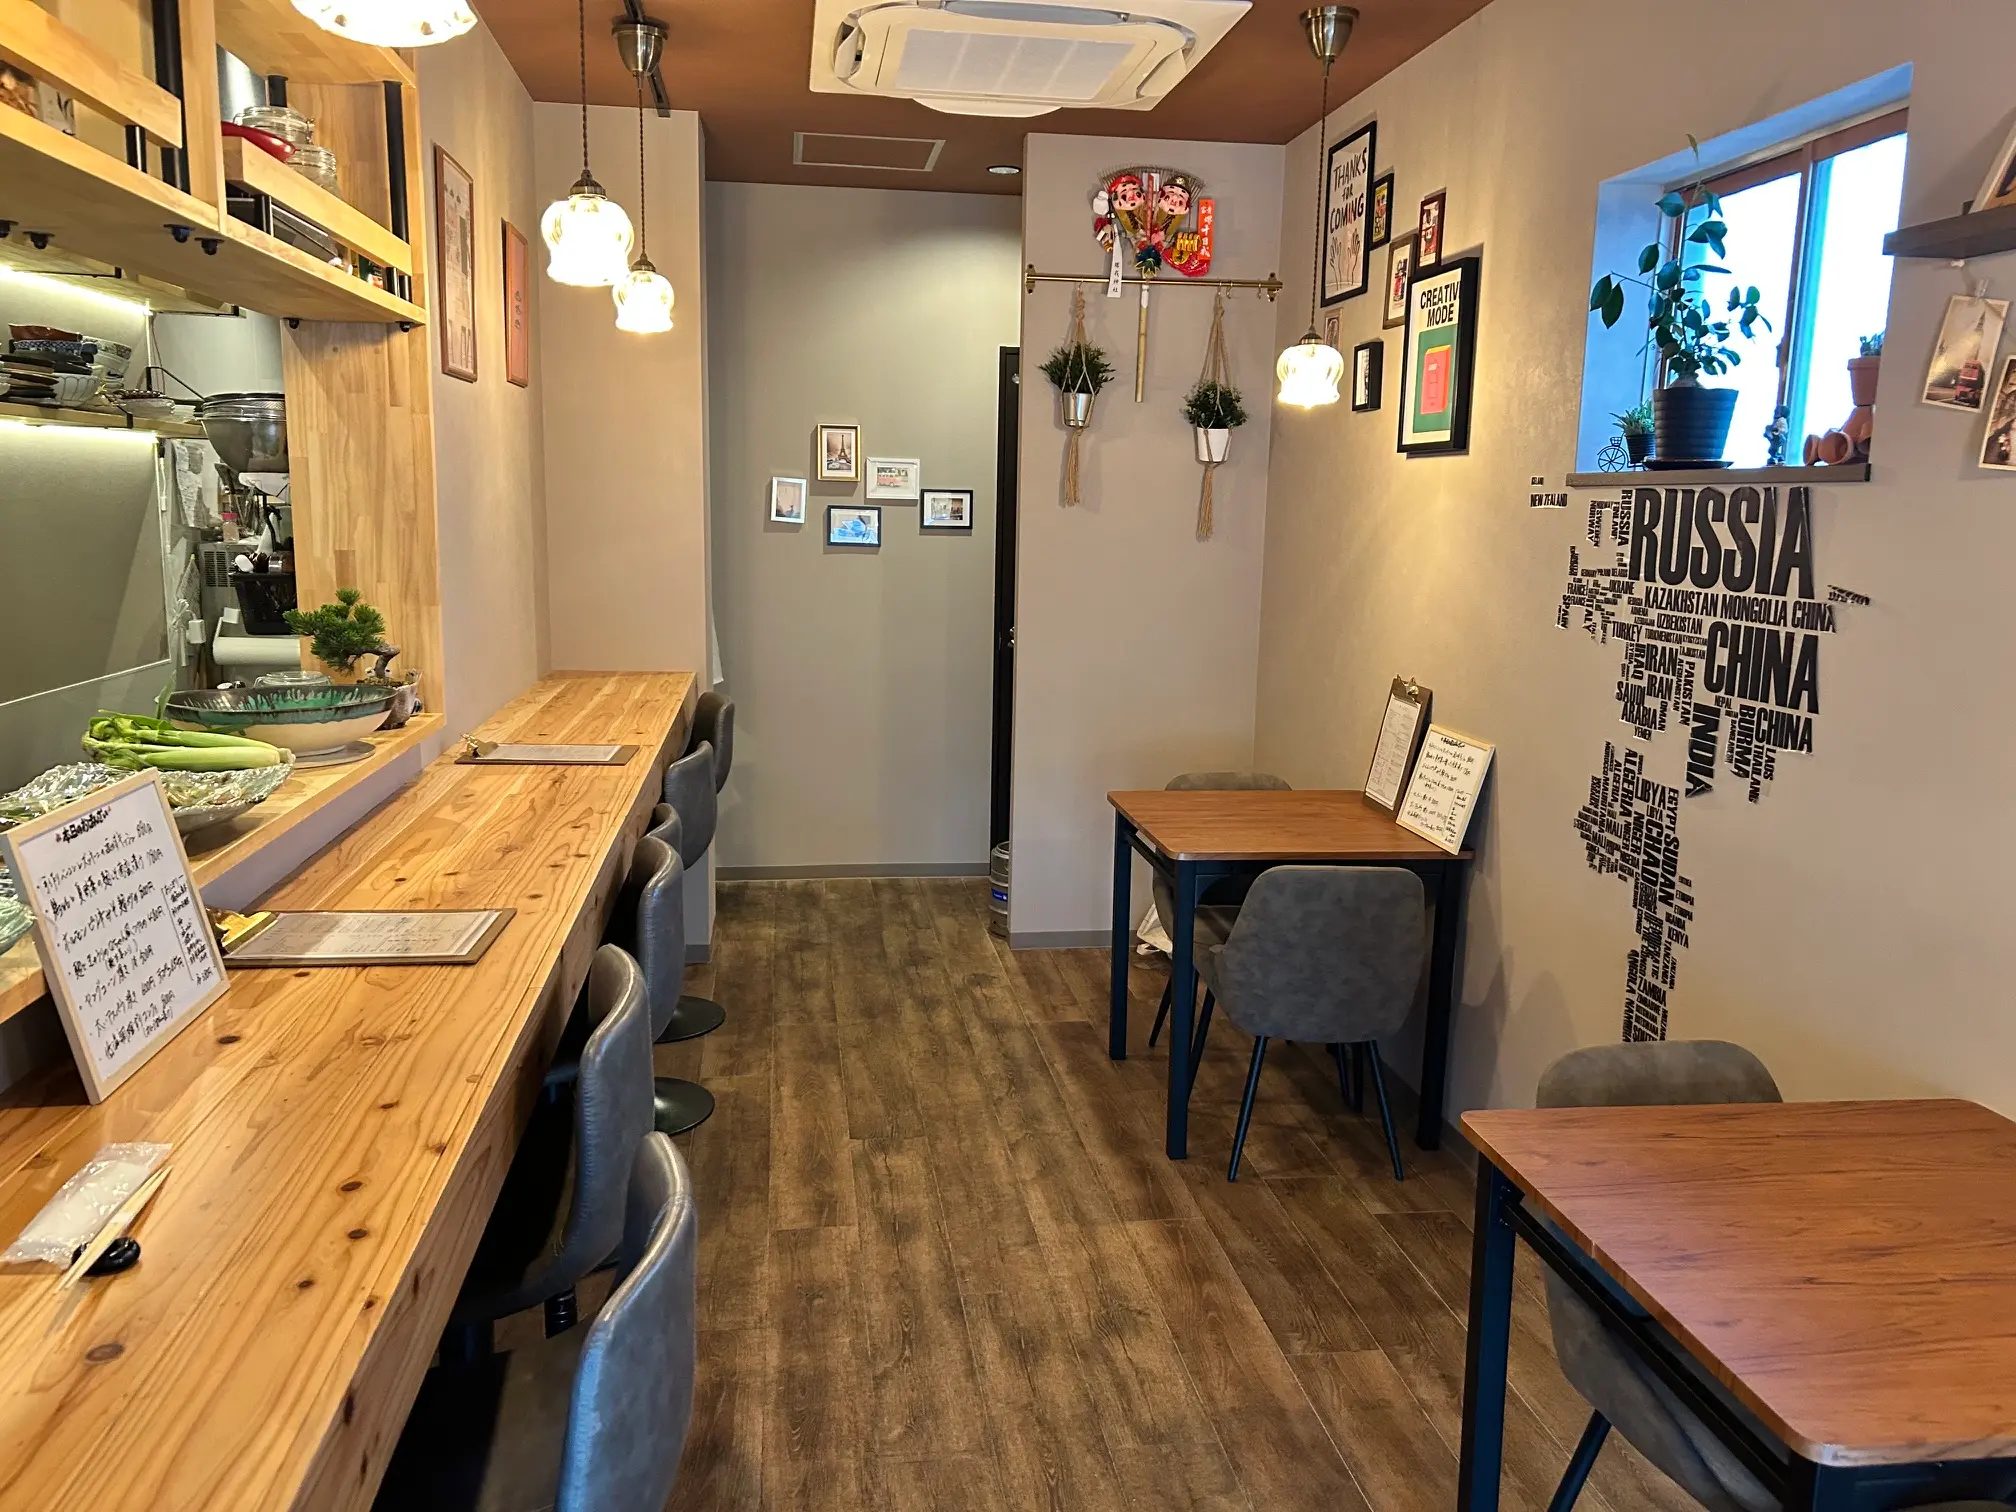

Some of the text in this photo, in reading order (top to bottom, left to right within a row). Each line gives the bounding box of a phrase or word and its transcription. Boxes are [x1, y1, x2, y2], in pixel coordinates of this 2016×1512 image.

[1333, 147, 1367, 192] THANKS
[1342, 183, 1353, 201] FOR
[1330, 193, 1364, 233] COMING
[1420, 281, 1461, 310] CREATIV
[1426, 303, 1454, 328] MODE
[1530, 493, 1567, 507] NEW ZEALAND
[1588, 500, 1597, 541] NORWAY
[1593, 509, 1602, 547] SWEDEN
[1617, 489, 1632, 546] RUSSIA
[1628, 486, 1815, 600] RUSSIA
[1567, 582, 1586, 595] FRANCE
[1608, 579, 1635, 595] UKRAINE
[1560, 595, 1570, 628] SPAIN
[1644, 585, 1719, 618] KAZAKHSTAN
[1720, 593, 1787, 627] MONGOLIA
[1791, 600, 1836, 633] CHINA
[1656, 612, 1703, 635] UZBEKISTAN
[1611, 620, 1643, 642] TURKEY
[1631, 642, 1646, 680] IRAQ
[1644, 642, 1679, 677] IRAN
[1703, 620, 1819, 715] CHINA
[1616, 681, 1646, 706] SAUDI
[1646, 673, 1674, 701] IRAN
[1679, 660, 1696, 727] PAKISTAN
[1714, 694, 1732, 709] NEPAL
[1621, 699, 1657, 730] ARABIA
[1754, 706, 1813, 753] CHINA
[1633, 725, 1652, 741] YEMEN
[1685, 702, 1721, 798] INDIA
[1730, 703, 1756, 779] BURMA
[1763, 747, 1777, 781] LAOS
[1619, 747, 1638, 818] ALGERIA
[1634, 776, 1667, 810] LIBYA
[1665, 786, 1679, 834] EGYPT
[1591, 830, 1607, 850] MALI
[1605, 817, 1622, 839] MALI
[1629, 810, 1645, 856] NIGER
[1641, 818, 1664, 888] CHAD
[1658, 832, 1680, 908] SUDAN
[1667, 926, 1689, 949] KENYA
[1637, 975, 1667, 1008] ZAMBIA
